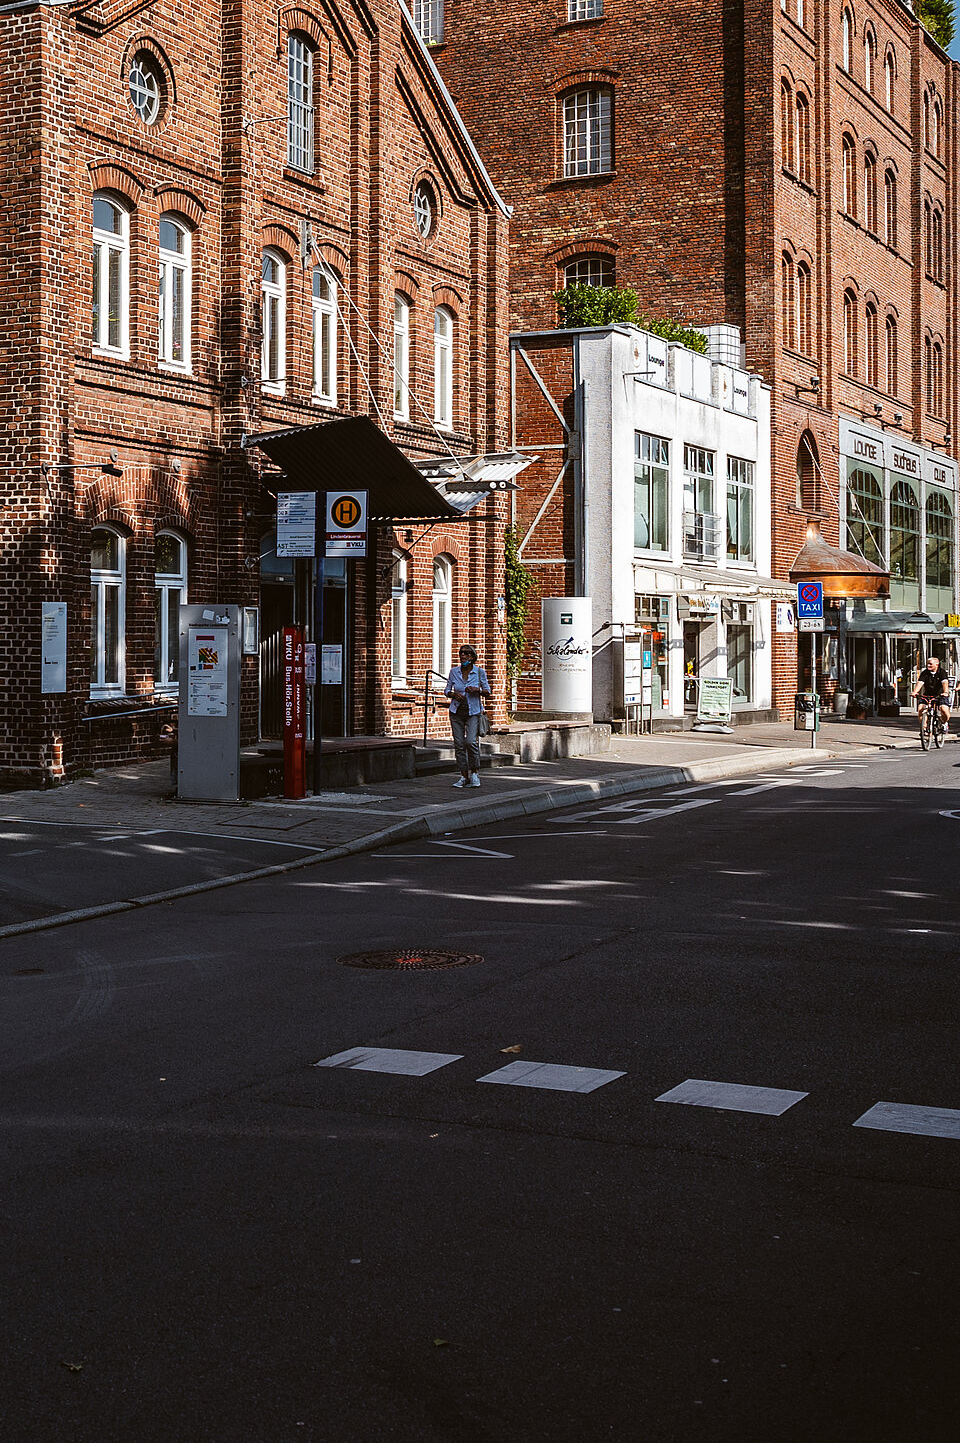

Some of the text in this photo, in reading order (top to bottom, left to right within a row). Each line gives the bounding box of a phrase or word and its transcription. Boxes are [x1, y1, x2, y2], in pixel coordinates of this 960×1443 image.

[648, 353, 665, 367] Lounge
[340, 503, 352, 521] H
[801, 603, 821, 612] TAXI
